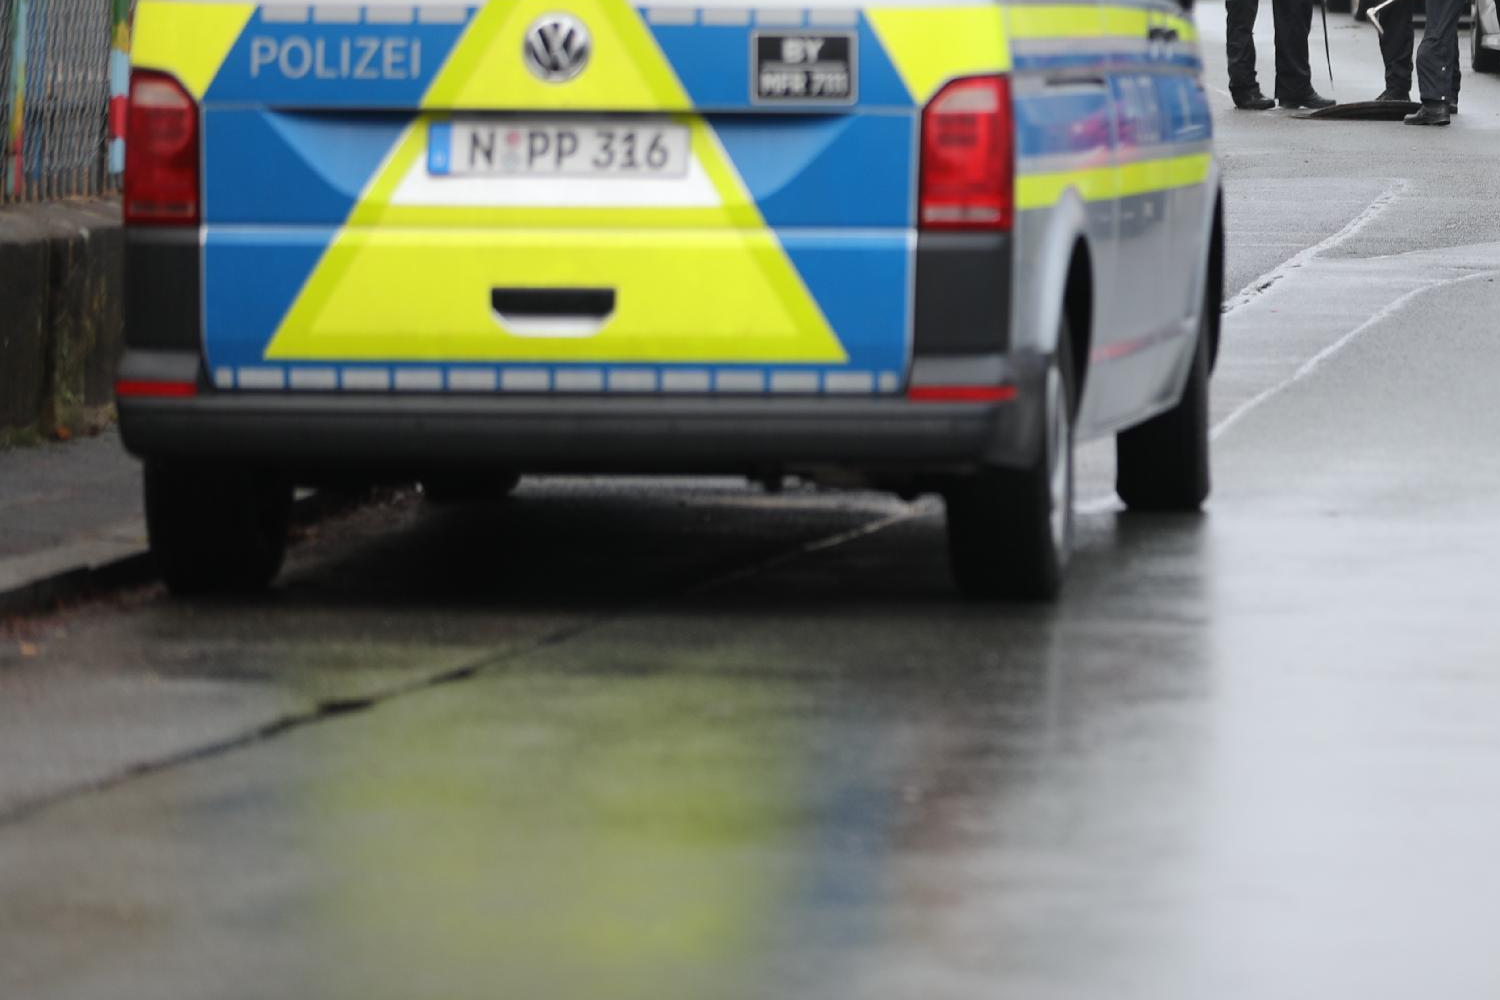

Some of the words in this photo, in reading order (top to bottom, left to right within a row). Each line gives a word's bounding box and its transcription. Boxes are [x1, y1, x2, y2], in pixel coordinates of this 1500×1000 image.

[250, 35, 422, 80] POLIZEI
[469, 130, 495, 167] N
[528, 130, 579, 167] PP
[592, 130, 670, 169] 316
